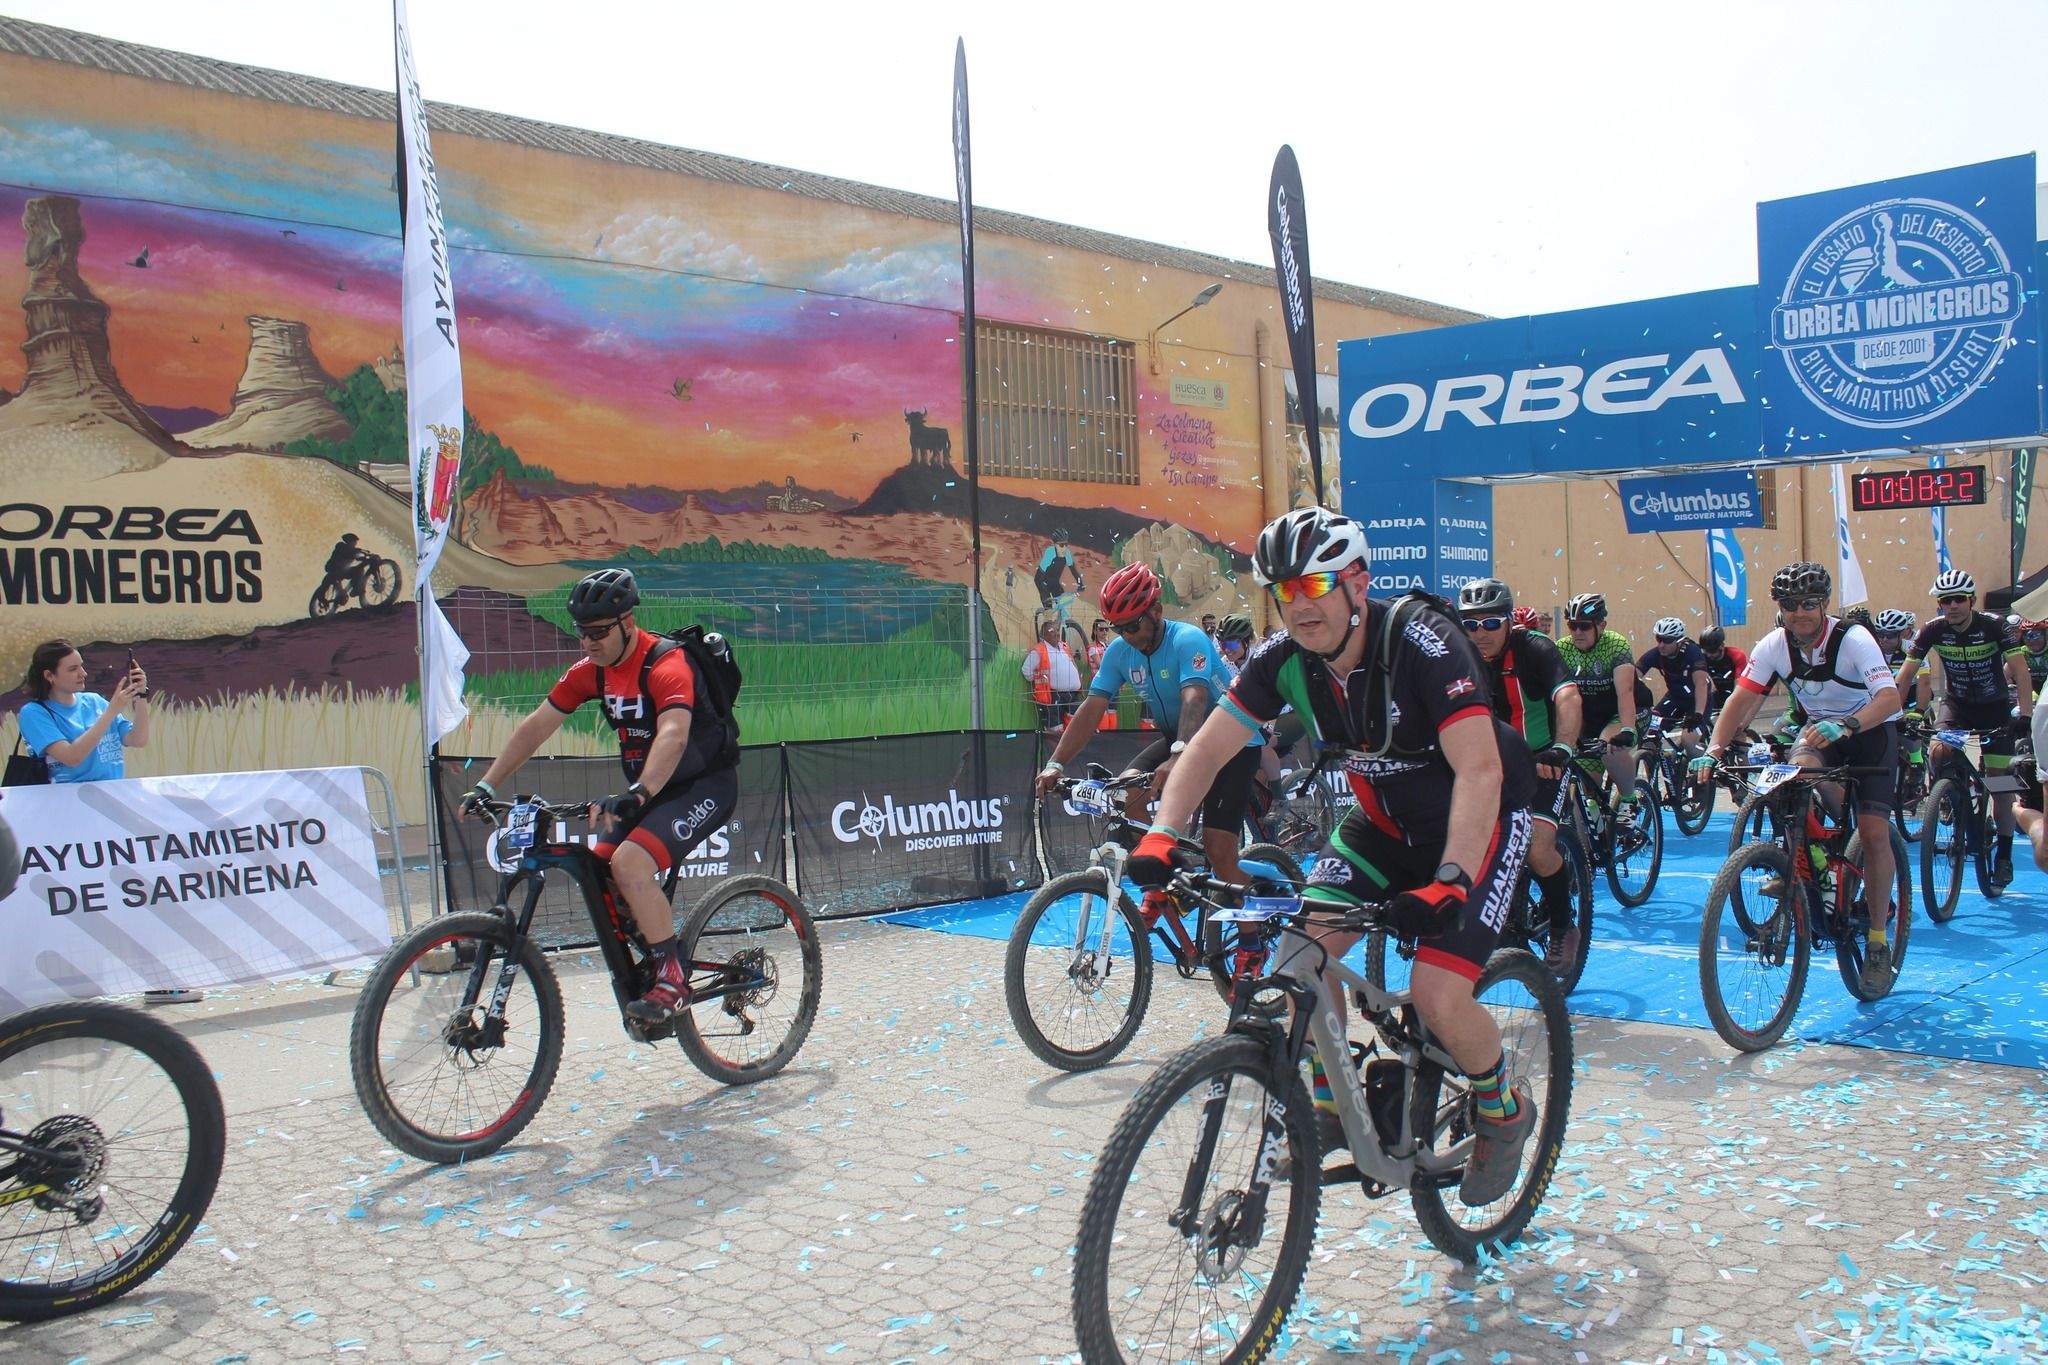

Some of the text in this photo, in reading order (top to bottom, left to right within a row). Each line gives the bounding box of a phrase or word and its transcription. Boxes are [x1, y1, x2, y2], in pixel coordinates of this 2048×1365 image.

[1277, 185, 1305, 327] Columbus
[1803, 213, 1986, 296] EL DESAFIO DEL DESIERTO
[1783, 280, 2010, 340] ORBEA MONEGROS
[1863, 337, 1926, 360] DESDE 2001
[1800, 329, 1994, 412] BIKE MARATHON DESERT
[1348, 348, 1746, 439] ORBEA
[1368, 517, 1426, 529] ADRIA
[1629, 489, 1751, 516] Columbus
[1674, 513, 1716, 521] DISCOVER
[0, 503, 263, 544] ORBEA
[1450, 519, 1488, 529] ADRIA
[1369, 545, 1427, 560] IMANO
[1440, 545, 1488, 561] SHIMANO
[0, 547, 263, 605] MONEGROS
[1368, 575, 1426, 589] KODA
[1076, 786, 1097, 800] 2897
[831, 789, 1003, 845] Columbus
[20, 818, 327, 875] AYUNTAMIENTO
[906, 831, 1004, 852] DISCOVER NATURE
[47, 860, 318, 916] DE SARIÑENA
[1325, 1011, 1372, 1136] ORBEA
